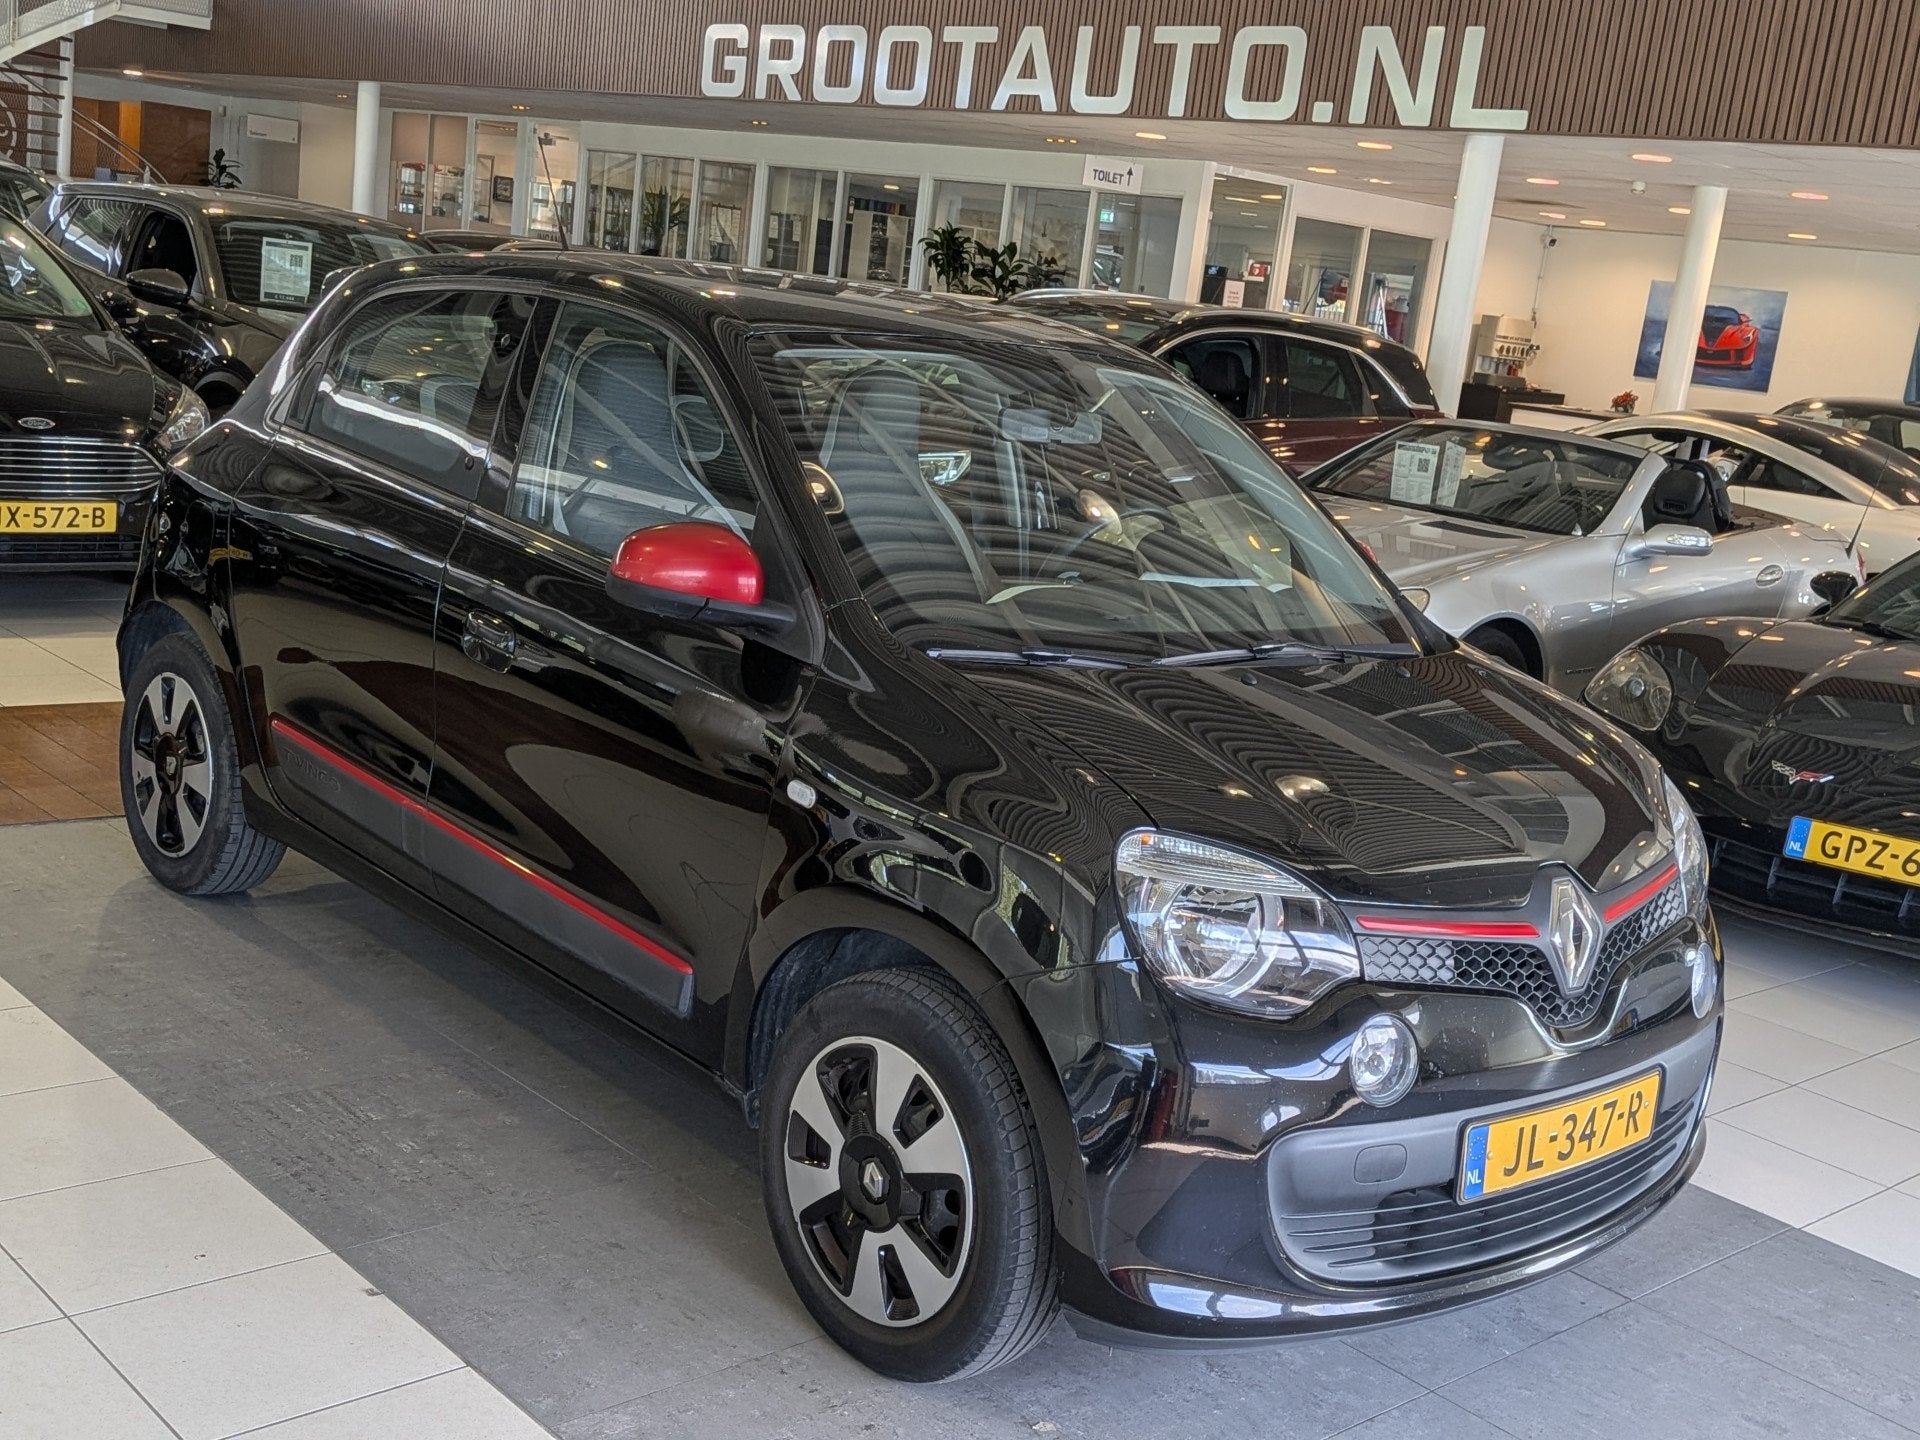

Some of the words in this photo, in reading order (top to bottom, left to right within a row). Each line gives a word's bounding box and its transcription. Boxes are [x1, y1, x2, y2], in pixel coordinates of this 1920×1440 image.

[701, 23, 1529, 131] GROOTAUTO.NL
[1092, 168, 1124, 185] TOILET
[0, 506, 106, 528] X-572-B
[283, 746, 341, 792] TWINGO
[1788, 840, 1803, 852] NL
[1503, 1090, 1643, 1177] JL-347-R
[1467, 1168, 1482, 1187] NL
